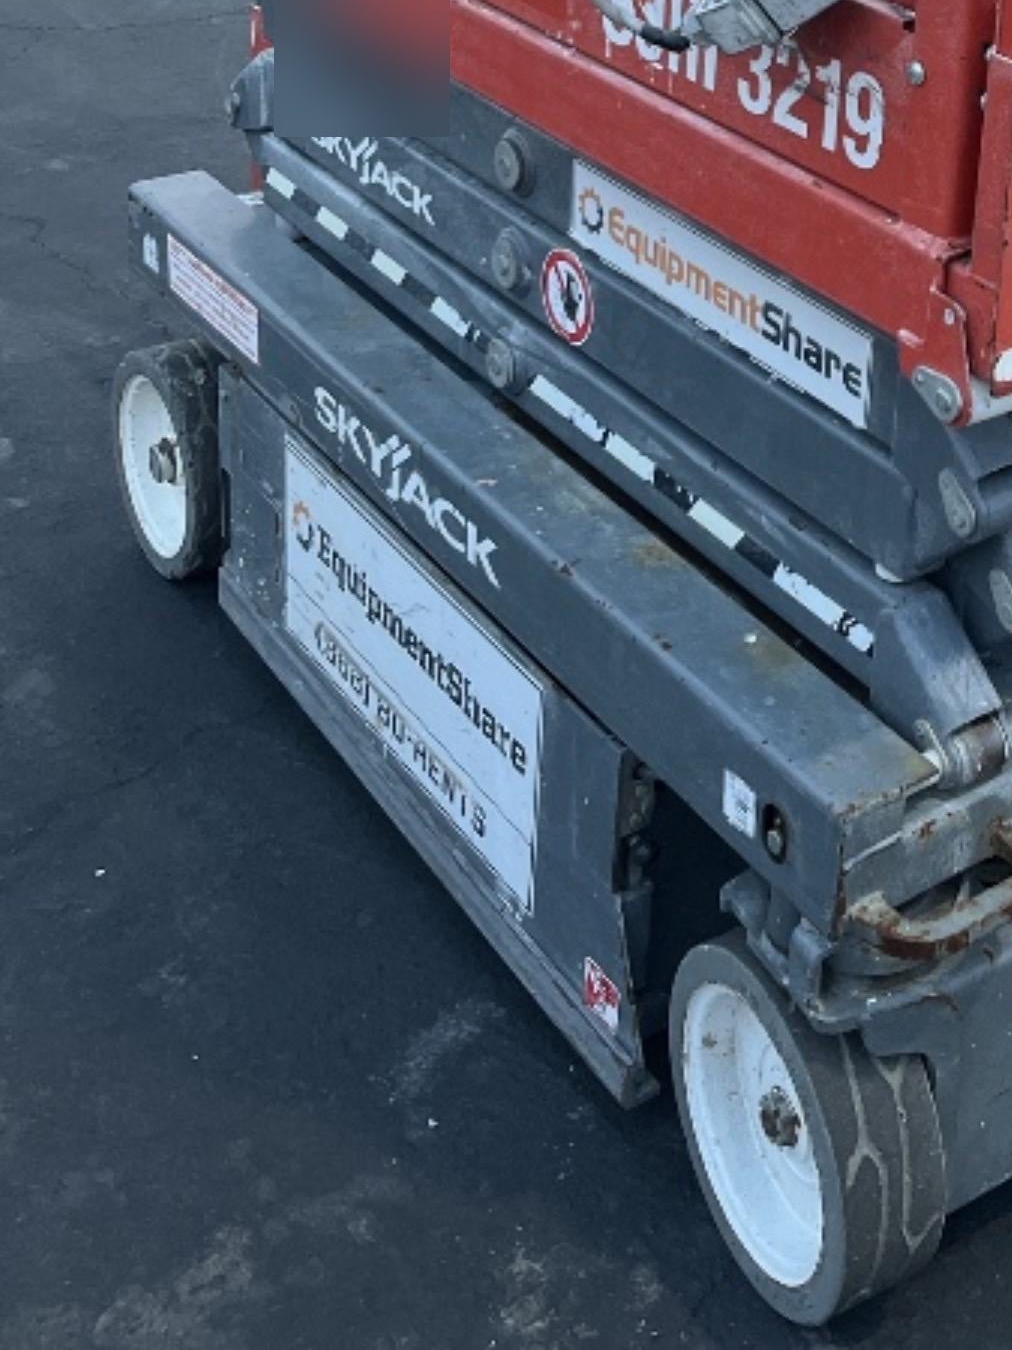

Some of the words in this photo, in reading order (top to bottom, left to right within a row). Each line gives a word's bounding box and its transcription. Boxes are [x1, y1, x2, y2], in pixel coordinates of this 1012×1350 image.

[737, 41, 886, 170] 3219
[608, 206, 862, 398] EquipmentShare
[313, 386, 502, 590] SKYJACK
[316, 523, 527, 776] EquipmentShare
